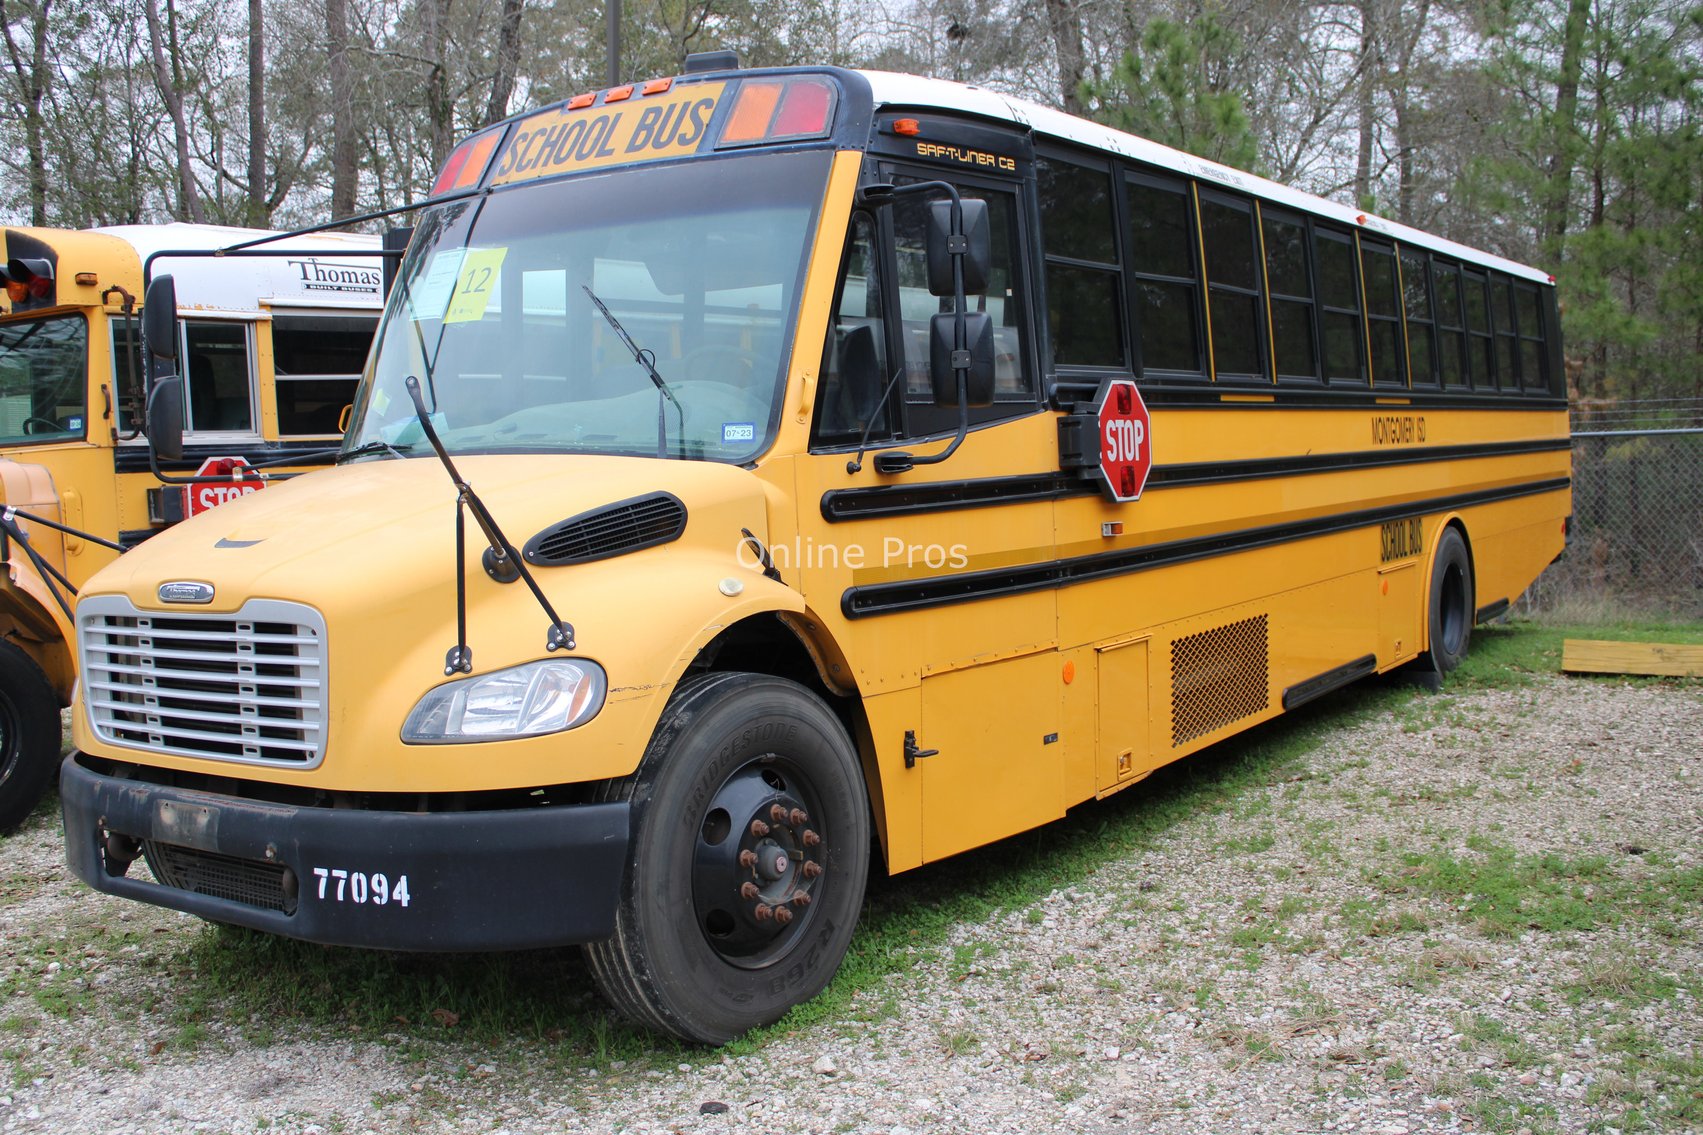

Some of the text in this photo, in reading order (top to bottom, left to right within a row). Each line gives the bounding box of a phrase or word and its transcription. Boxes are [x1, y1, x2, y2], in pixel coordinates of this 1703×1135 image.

[499, 97, 714, 176] SCHOOL BUS
[998, 157, 1016, 170] C2
[287, 257, 382, 286] Thomas
[461, 267, 492, 295] 12
[1105, 419, 1144, 462] STOP
[1371, 417, 1416, 445] MONTGOMERY
[1381, 517, 1423, 562] SCHOOL BUS
[683, 721, 799, 828] BRIDGESTONE
[313, 867, 411, 907] 77094
